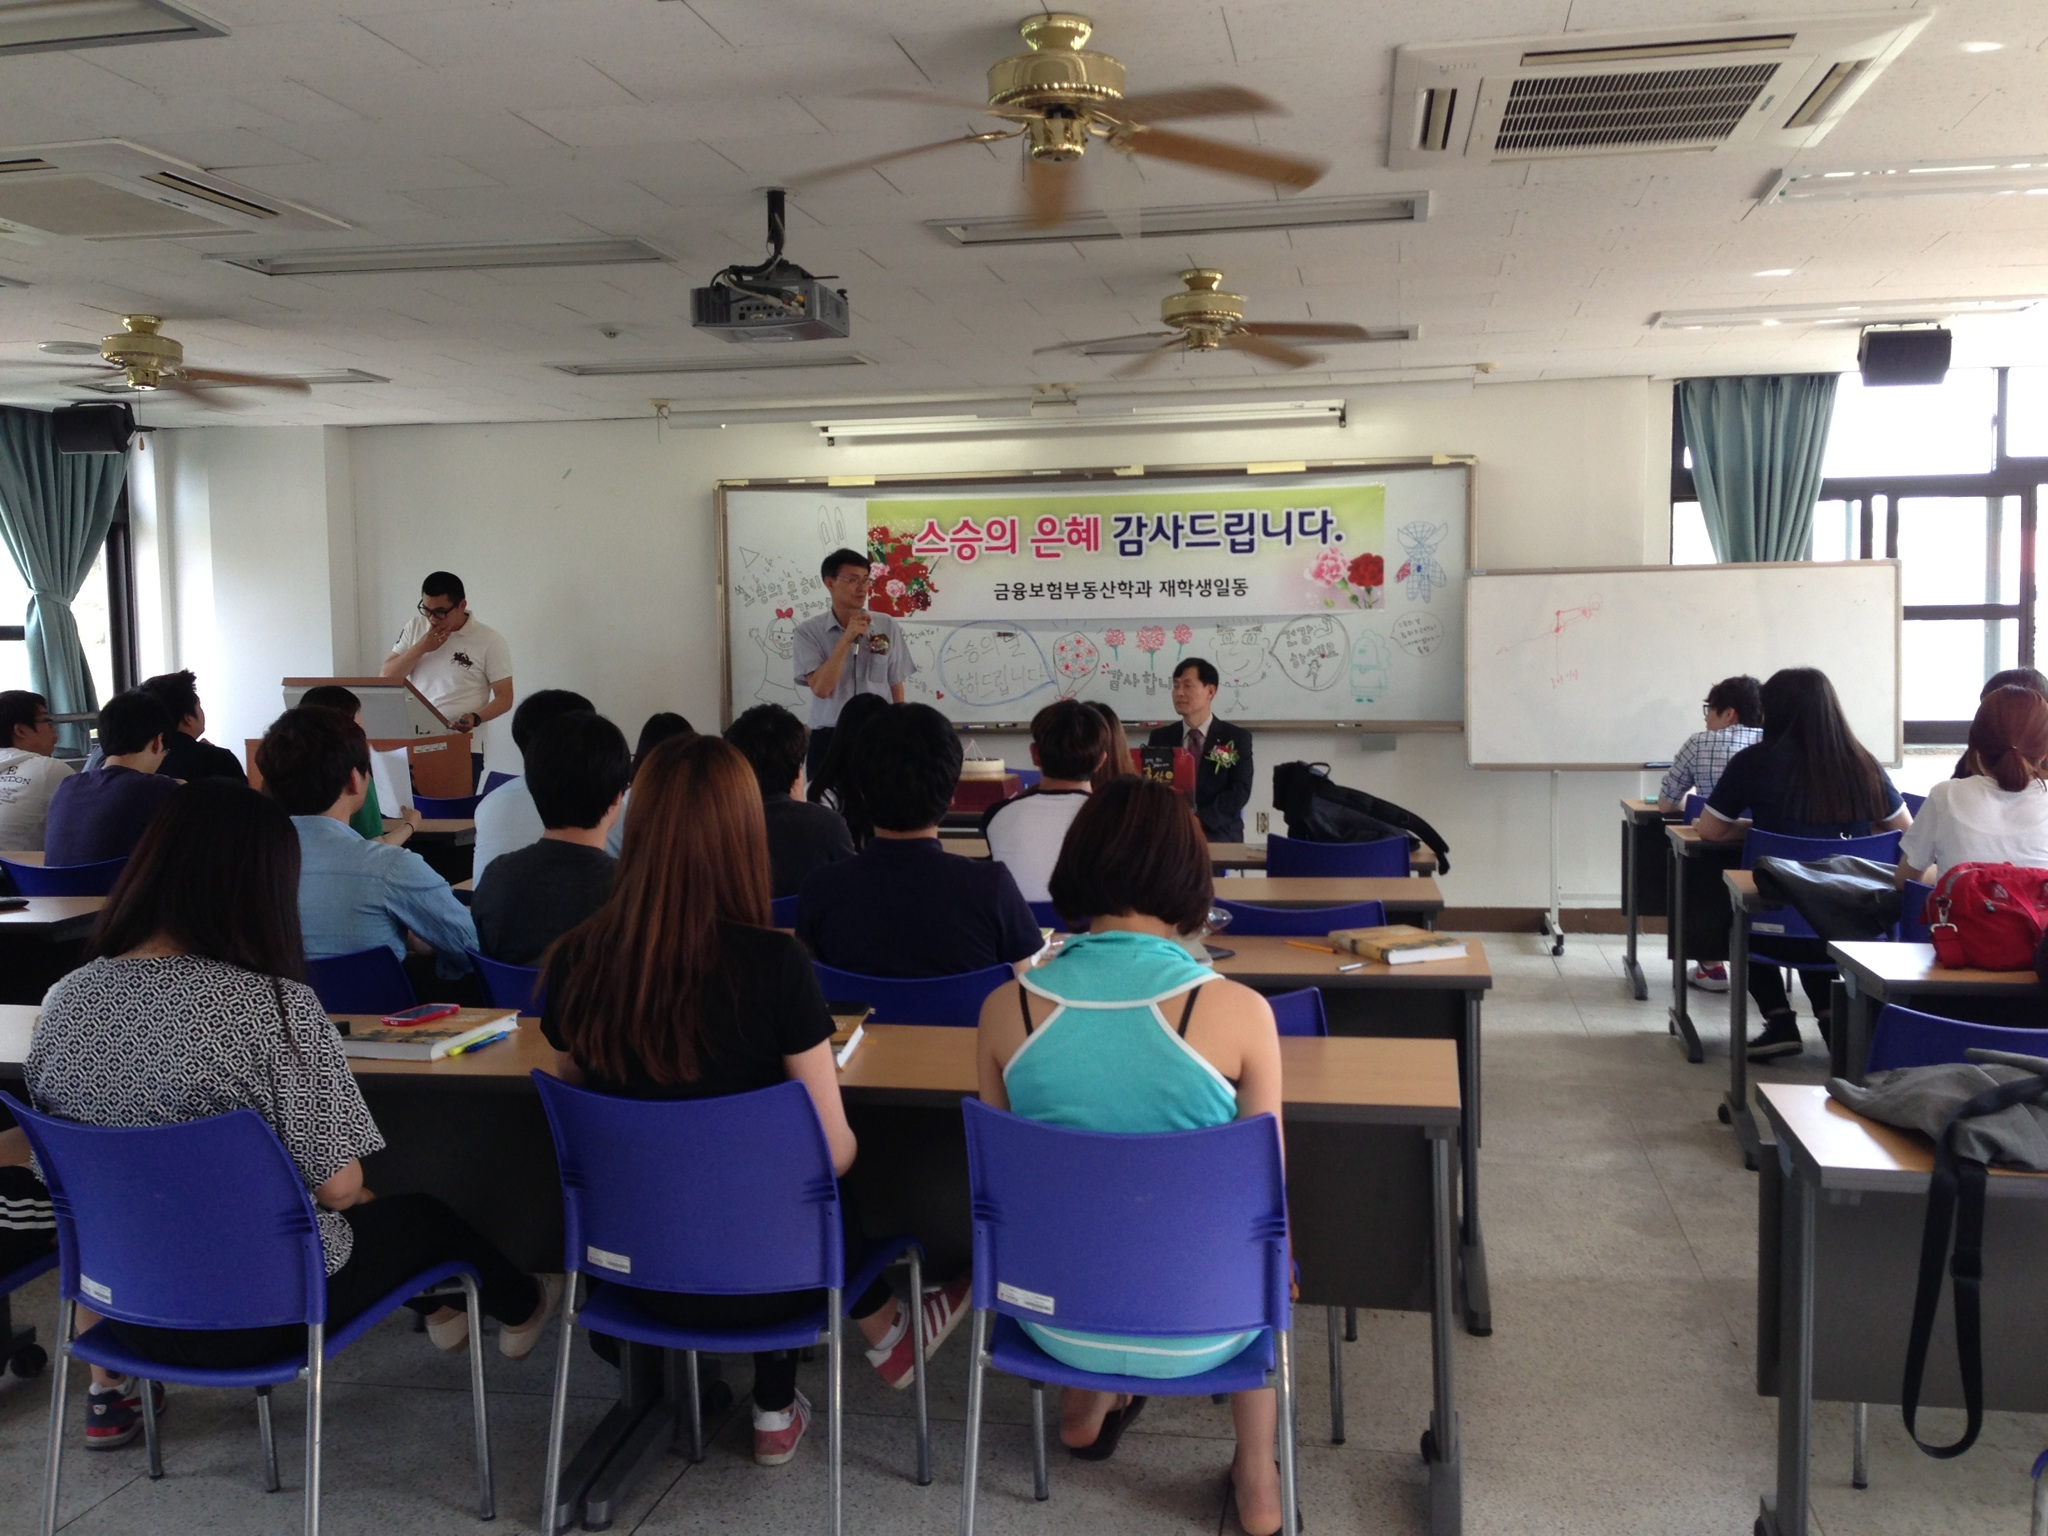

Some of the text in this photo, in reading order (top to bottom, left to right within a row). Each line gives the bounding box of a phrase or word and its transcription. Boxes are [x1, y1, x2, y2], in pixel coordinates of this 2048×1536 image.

[914, 508, 1344, 560] 스승의 은혜 감사드립니다.
[993, 578, 1249, 602] 금융보험부동산학과 재학생일동
[943, 636, 1000, 664] 스승의
[953, 663, 1046, 703] 축하드립니다
[1106, 668, 1173, 696] 감사합니
